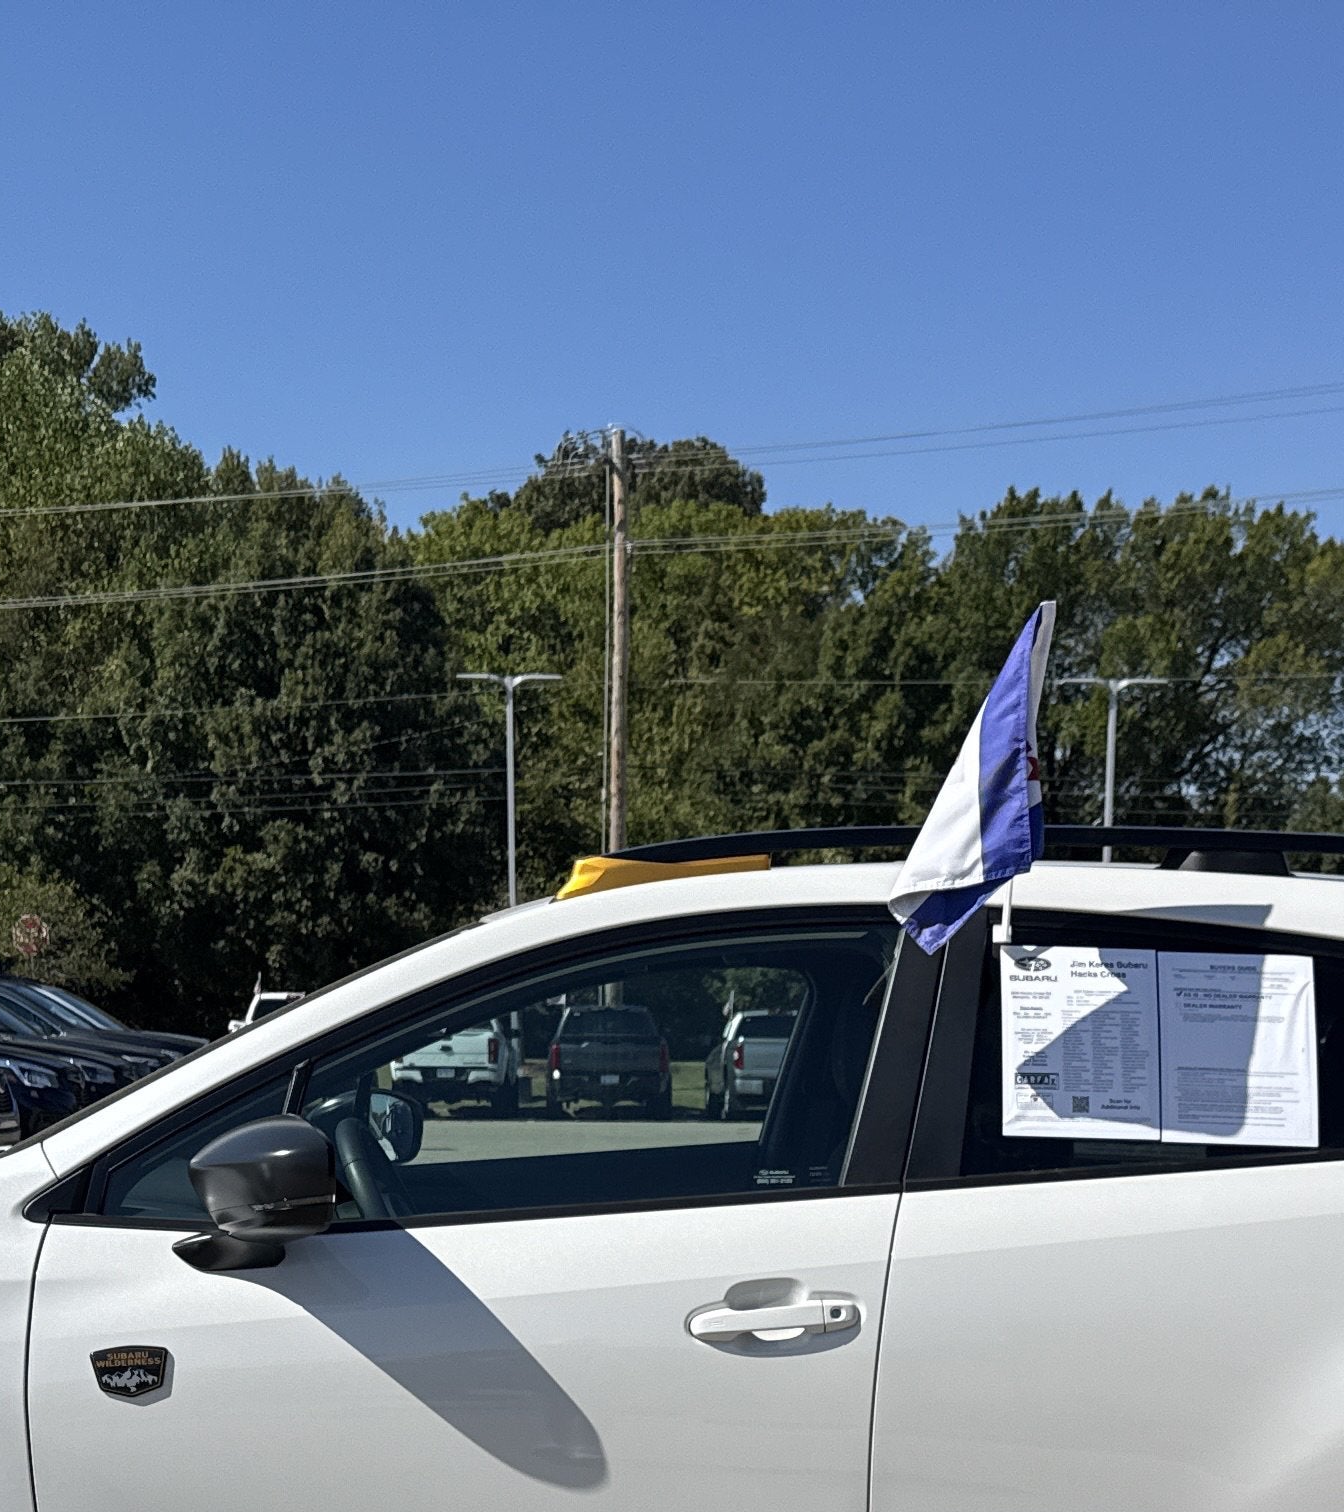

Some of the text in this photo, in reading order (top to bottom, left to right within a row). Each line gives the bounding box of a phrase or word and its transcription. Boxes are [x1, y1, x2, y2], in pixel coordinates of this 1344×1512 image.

[1009, 974, 1058, 983] SUBARU
[106, 1351, 149, 1360] SUBARU
[96, 1357, 162, 1368] WILDERNESS
